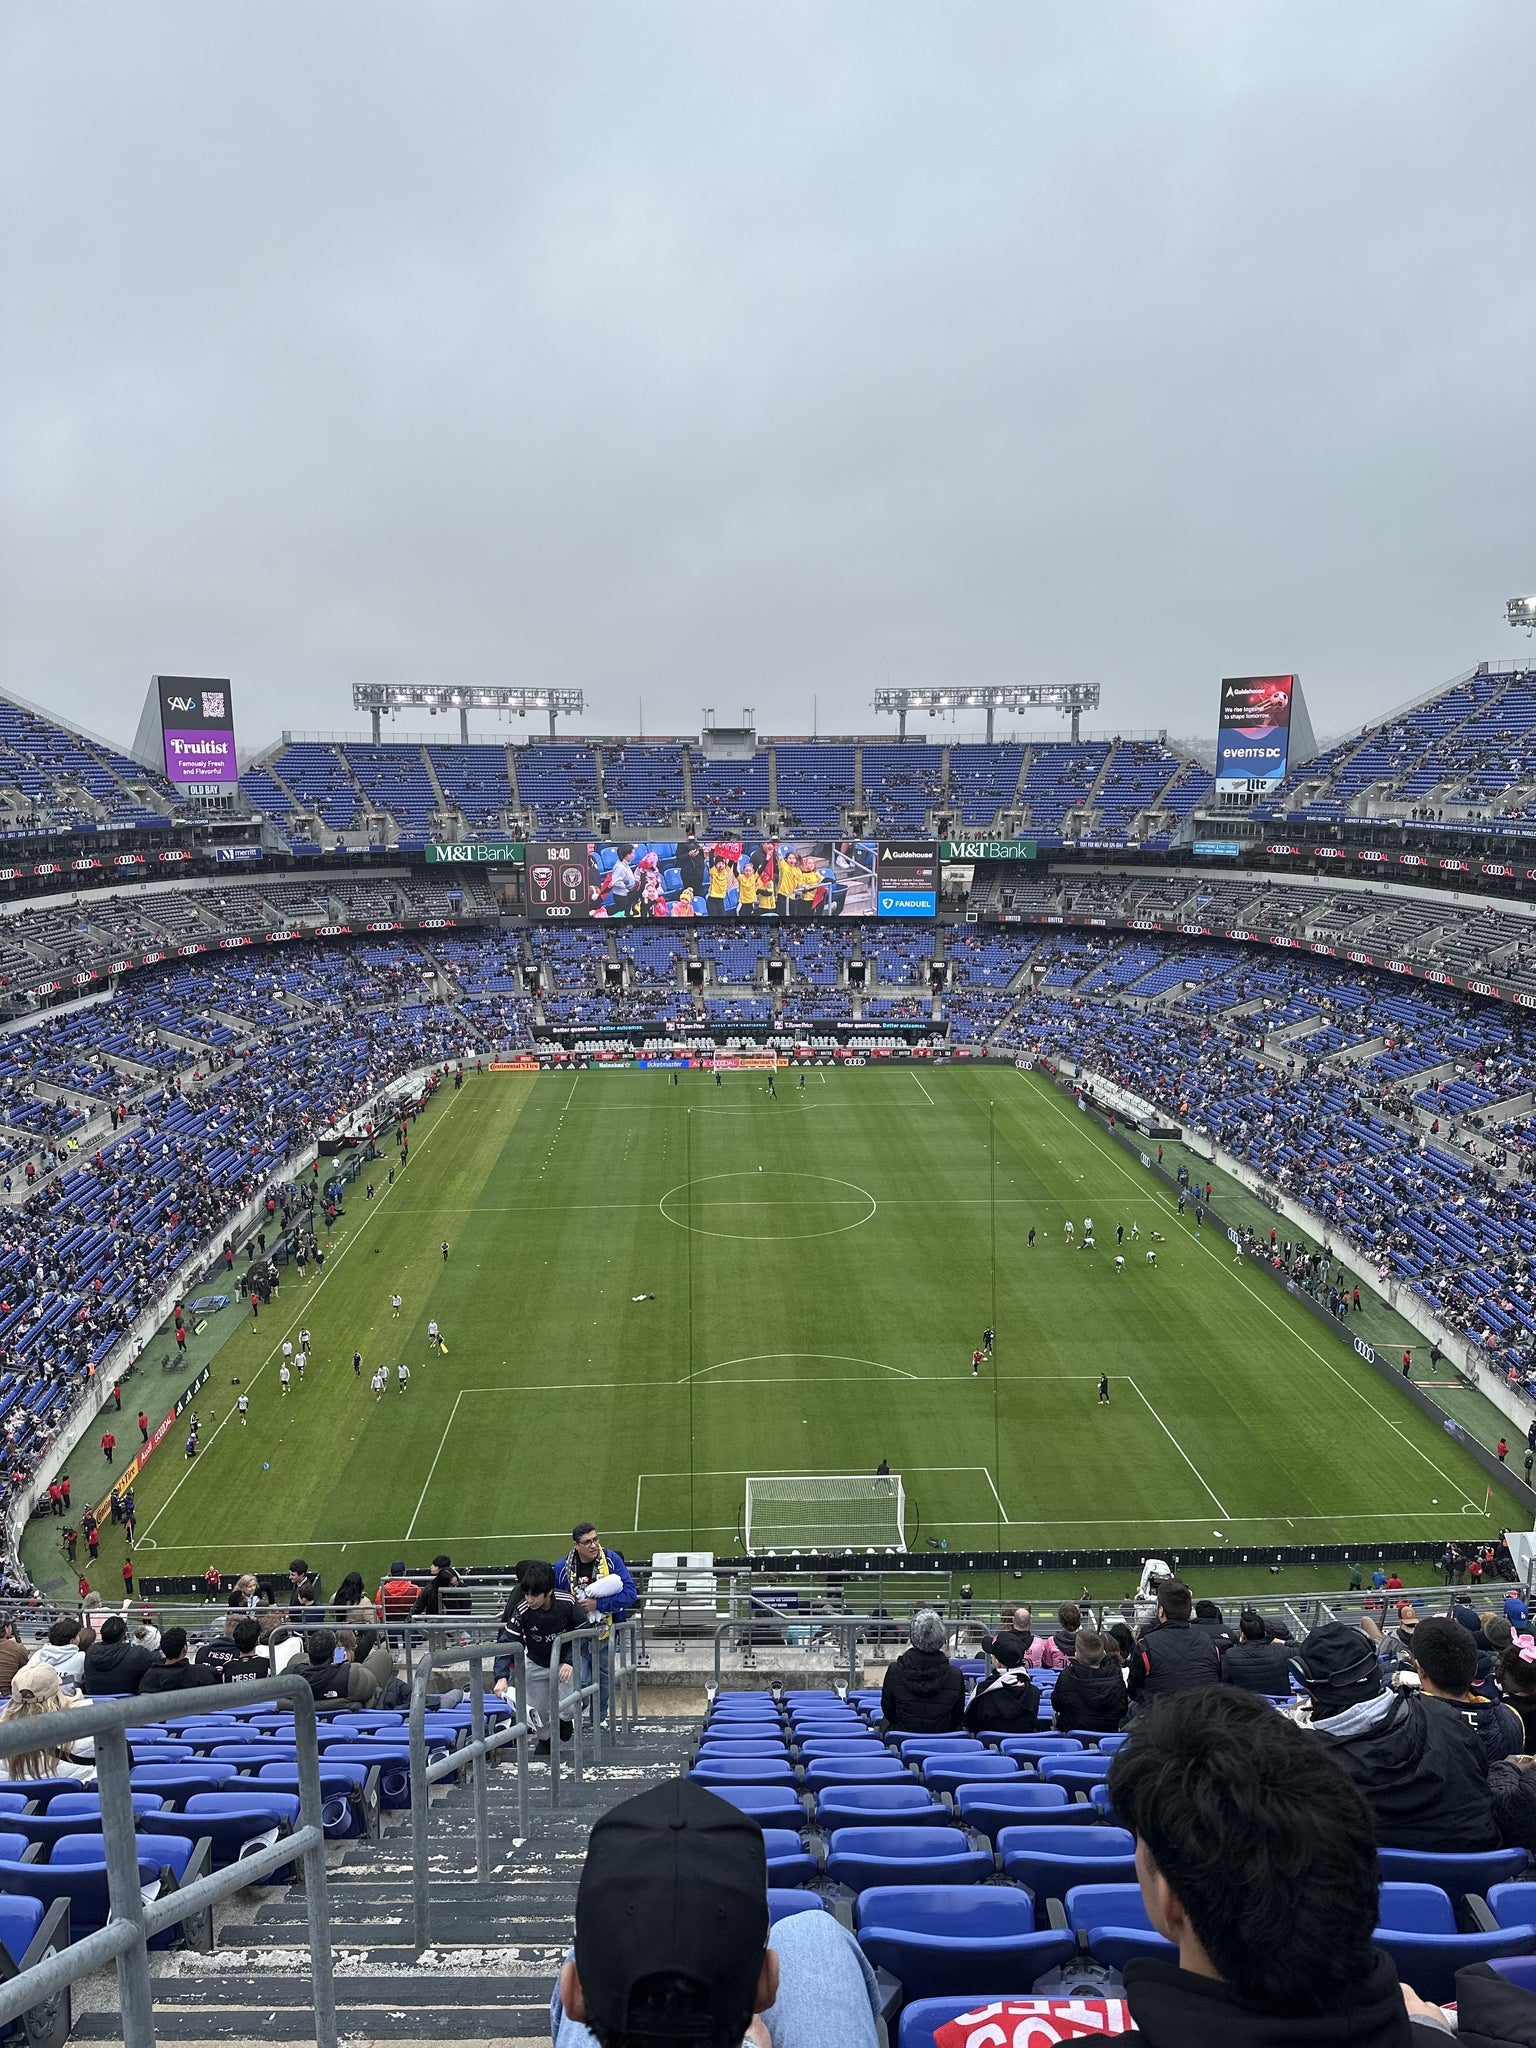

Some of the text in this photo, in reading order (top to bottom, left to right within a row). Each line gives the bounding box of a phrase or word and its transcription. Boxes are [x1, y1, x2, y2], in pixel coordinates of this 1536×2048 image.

[170, 738, 228, 754] Fruitist
[178, 760, 206, 768] Famously
[190, 785, 218, 795] OLD BAY
[1246, 779, 1266, 791] Lite
[436, 846, 515, 861] M&T Bank
[547, 848, 570, 860] 19:40
[950, 843, 1027, 858] M&T Bank
[541, 890, 547, 901] 0
[570, 889, 576, 901] 0
[208, 1651, 233, 1661] MESSI
[232, 1673, 256, 1682] MESSI
